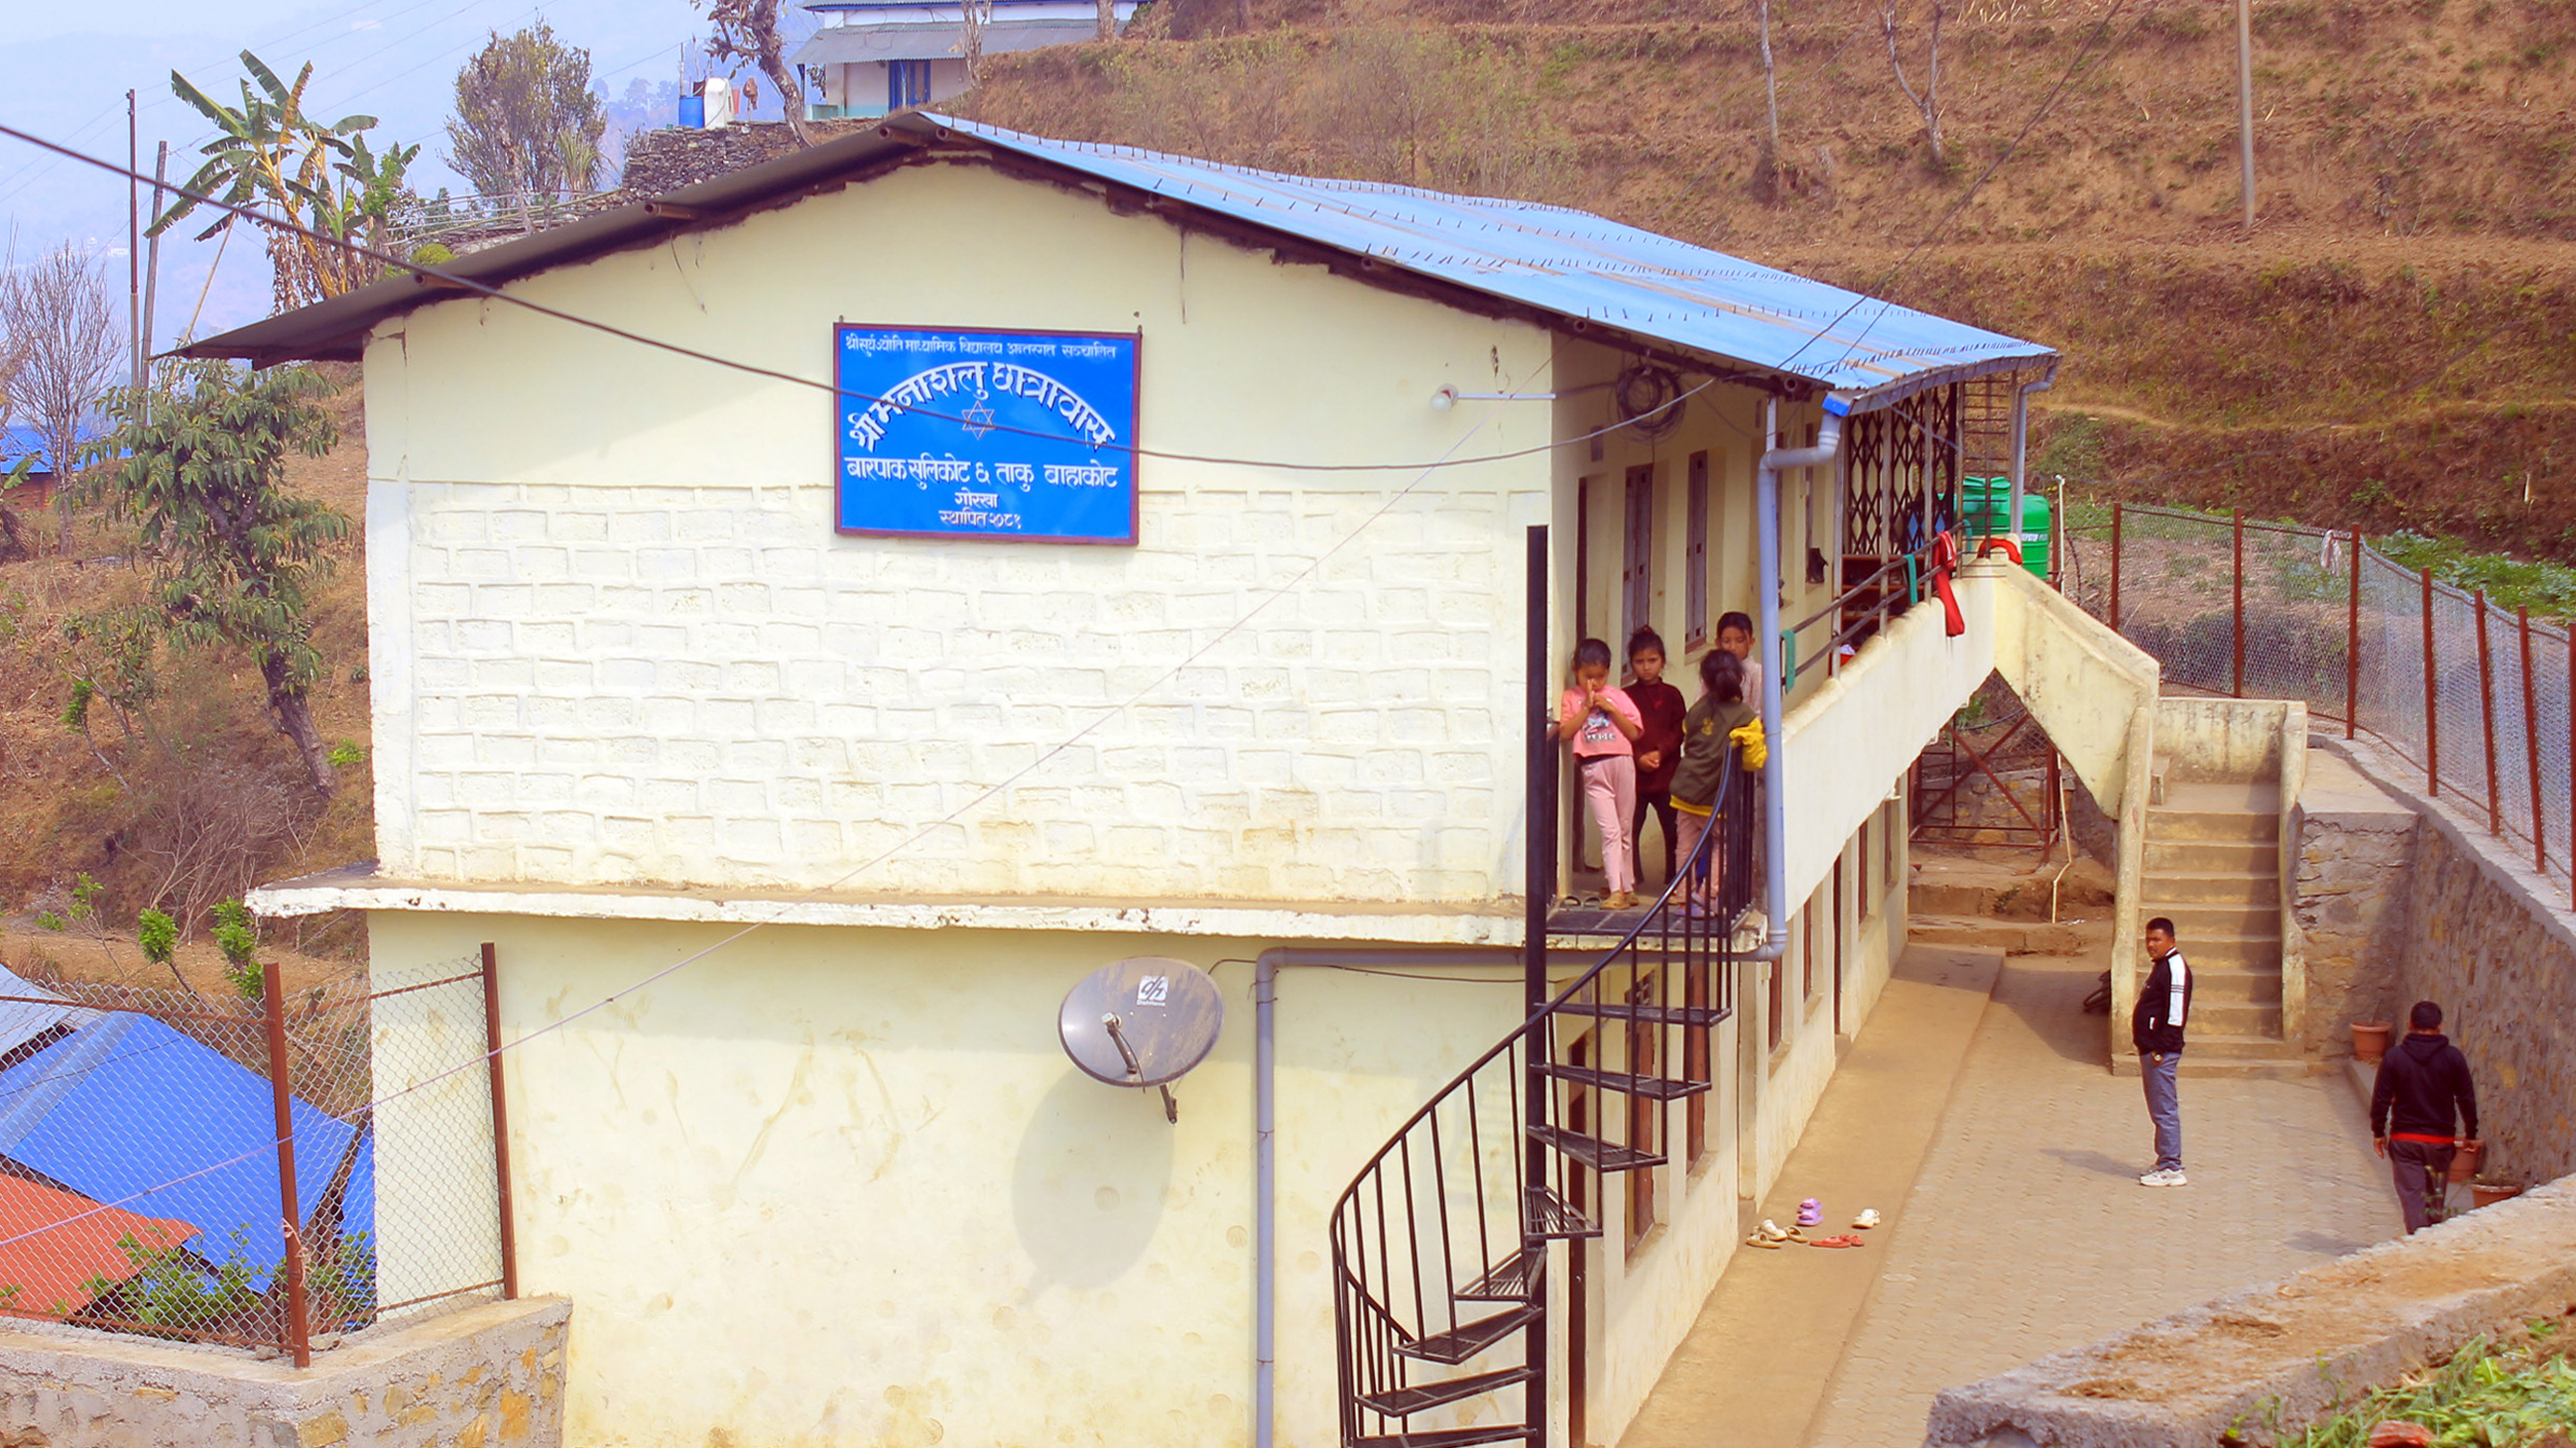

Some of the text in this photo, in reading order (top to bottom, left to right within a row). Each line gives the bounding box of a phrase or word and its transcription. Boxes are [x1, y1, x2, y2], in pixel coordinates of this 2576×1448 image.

[959, 337, 1003, 355] विद्यालय
[992, 362, 1115, 450] छात्रावास
[844, 457, 908, 481] बारपाक
[907, 452, 971, 490] सुलिकोट
[994, 462, 1035, 492] ताकु
[954, 487, 998, 509] गोरखा
[938, 507, 988, 528] स्थापित
